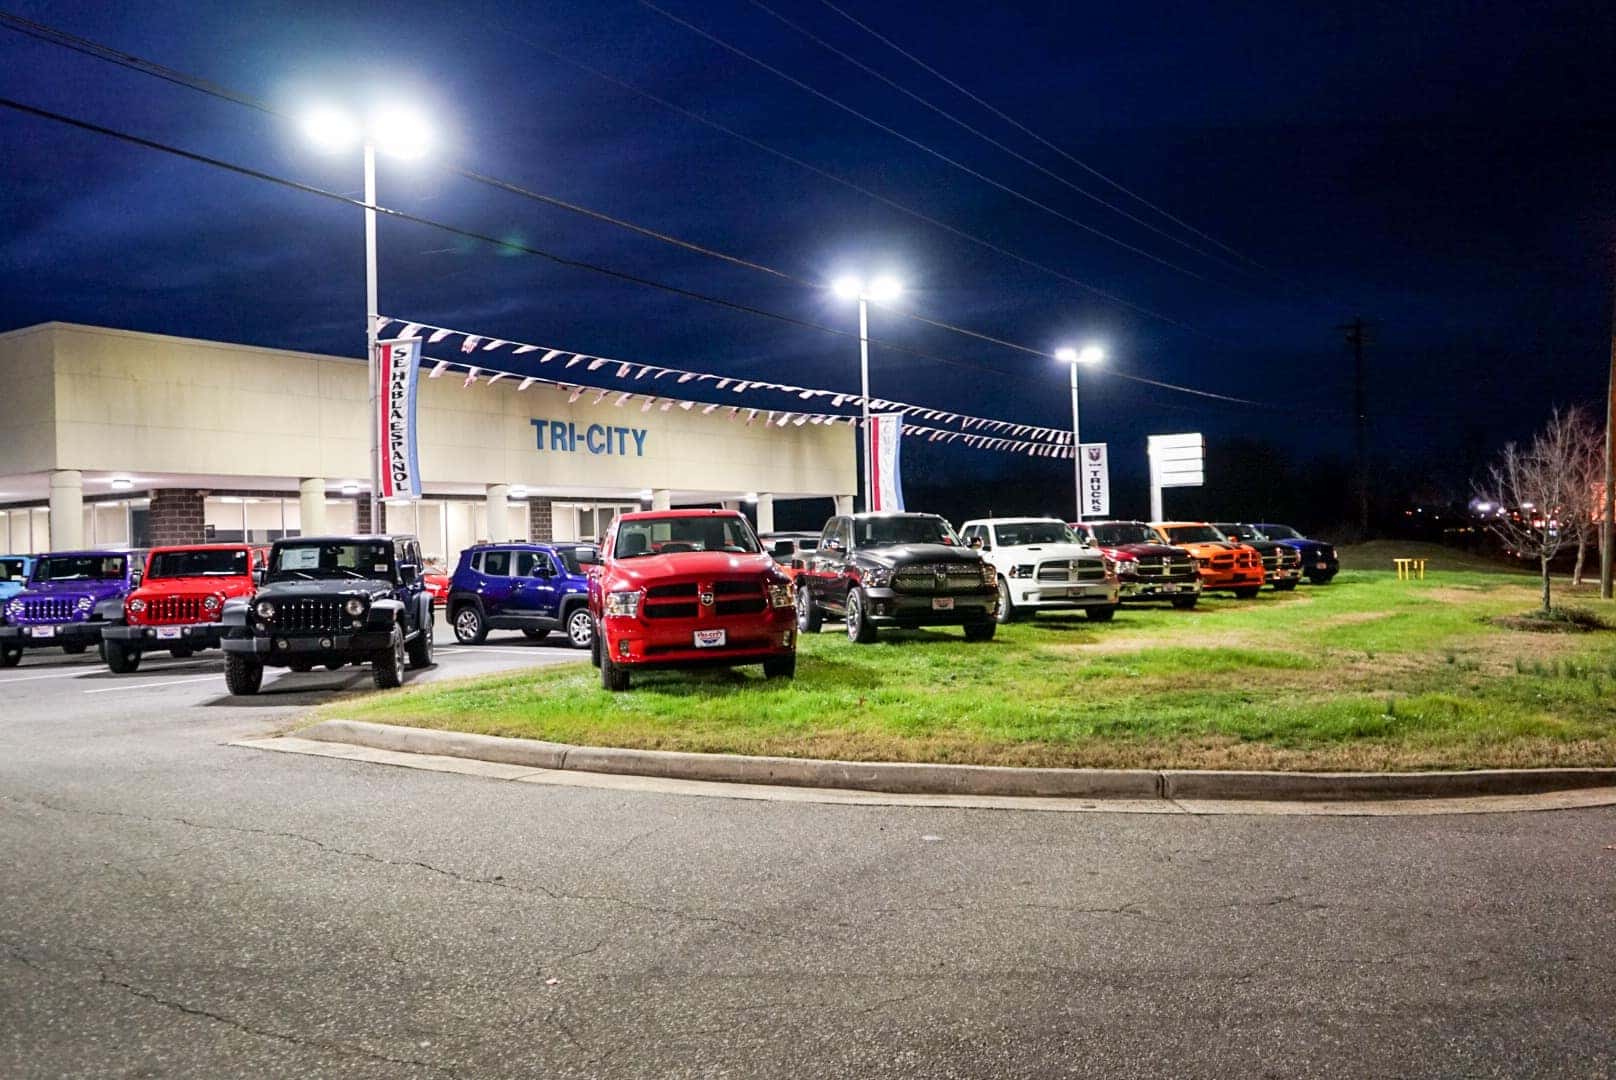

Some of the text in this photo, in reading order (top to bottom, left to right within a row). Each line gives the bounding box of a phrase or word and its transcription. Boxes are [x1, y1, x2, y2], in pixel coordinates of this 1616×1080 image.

[393, 349, 407, 368] SE
[391, 371, 406, 419] HABLA
[530, 418, 648, 457] TRI-CITY
[1090, 470, 1102, 512] TRUCKS
